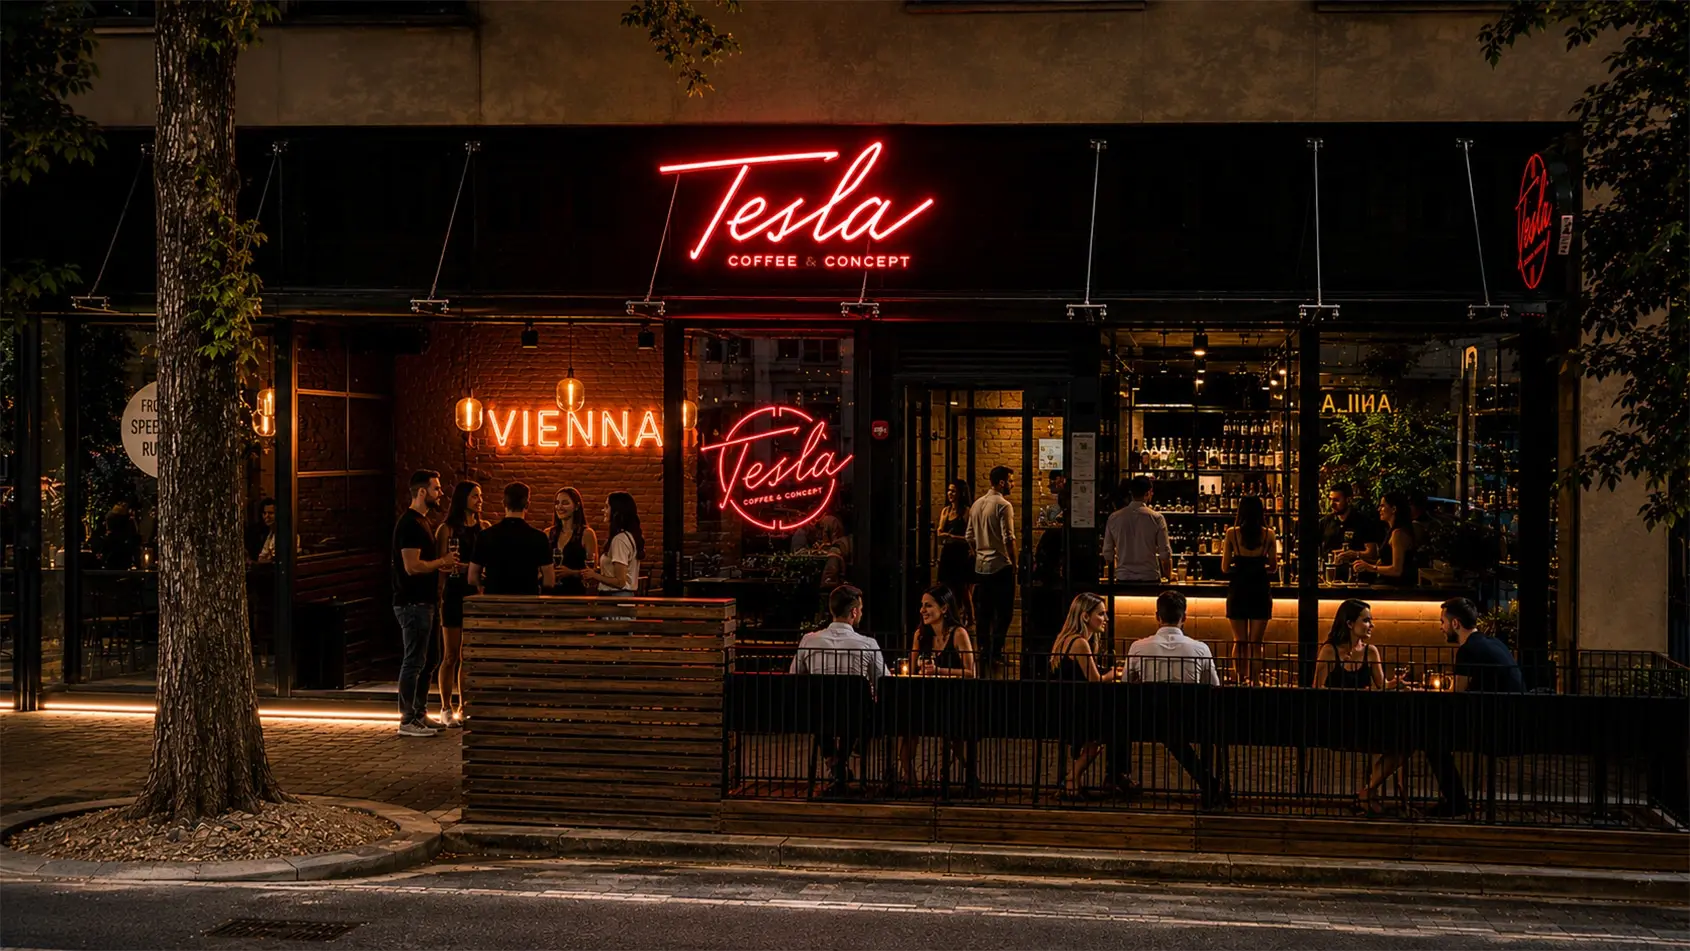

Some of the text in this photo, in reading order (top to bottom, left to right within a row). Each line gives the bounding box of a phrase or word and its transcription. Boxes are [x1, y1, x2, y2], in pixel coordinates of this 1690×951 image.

[659, 141, 934, 260] Tesla
[1515, 169, 1552, 270] Tesla
[728, 255, 911, 267] COFFEE & CONCEPT
[487, 409, 664, 447] VIENNA
[701, 421, 853, 509] Tesla
[743, 495, 775, 506] COFFEE
[784, 487, 823, 499] CONCEPT
